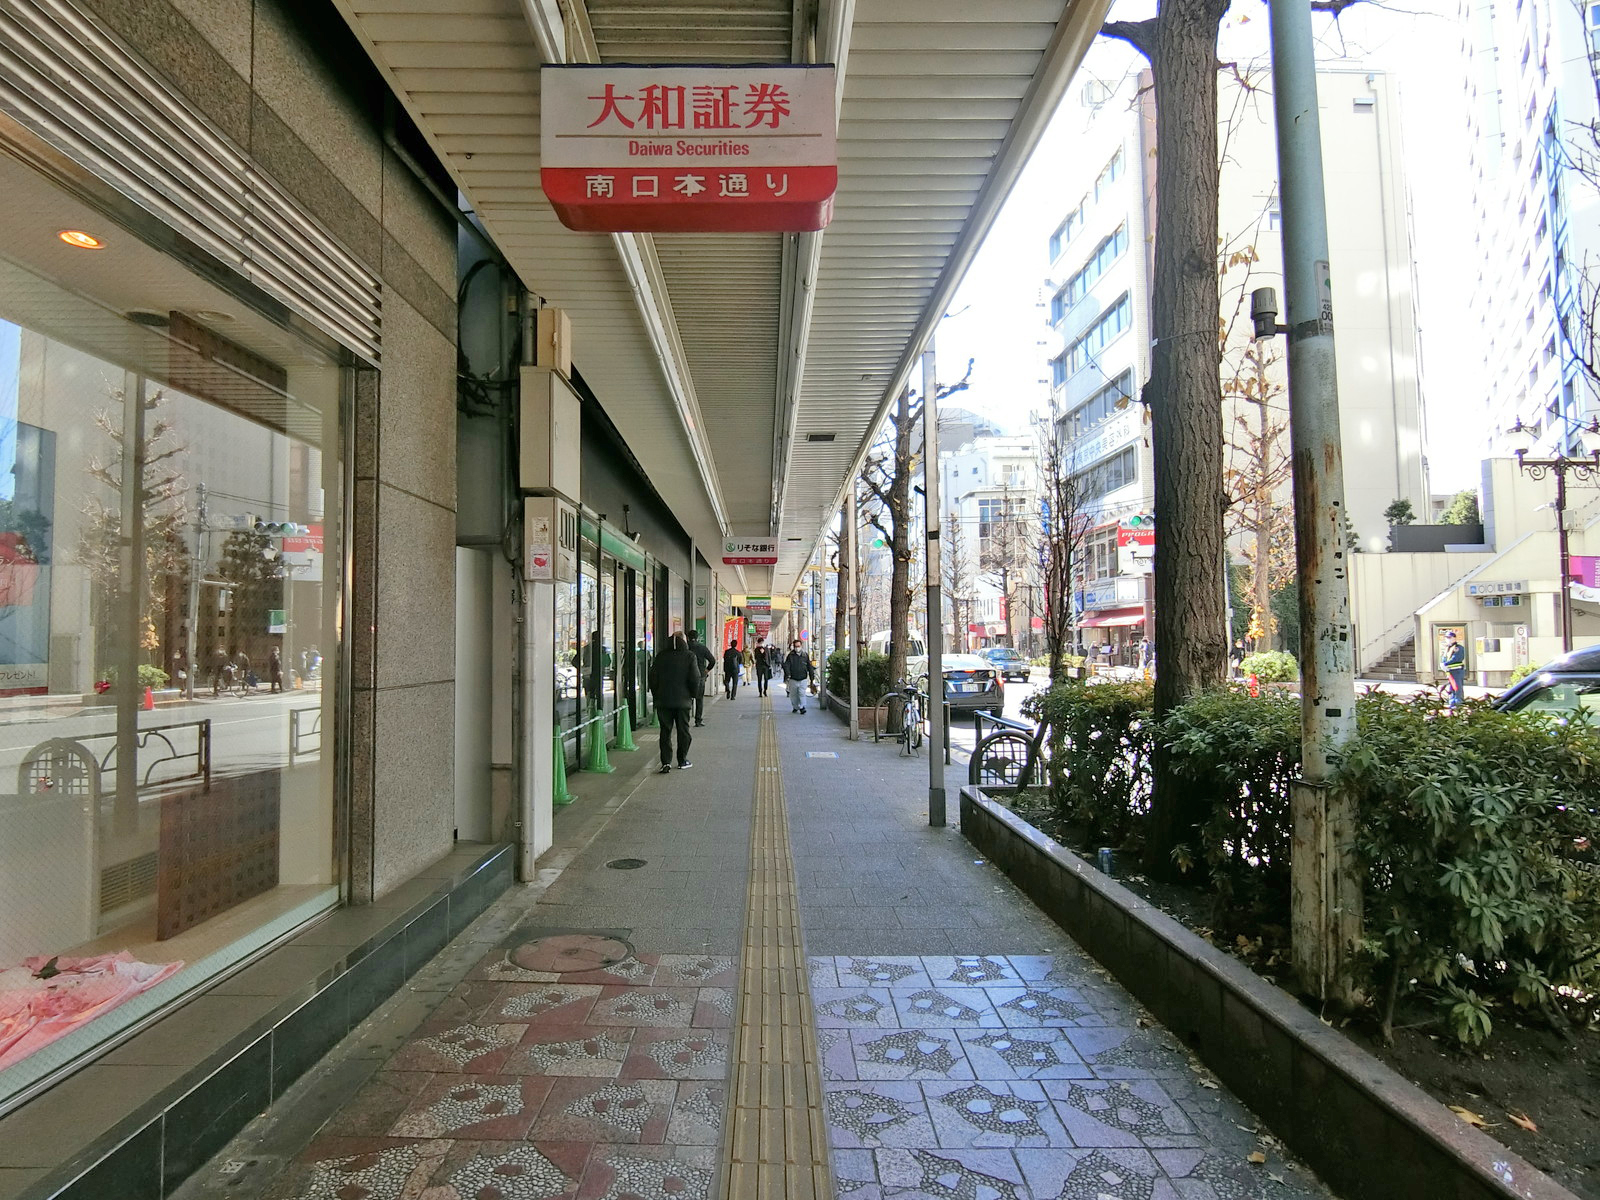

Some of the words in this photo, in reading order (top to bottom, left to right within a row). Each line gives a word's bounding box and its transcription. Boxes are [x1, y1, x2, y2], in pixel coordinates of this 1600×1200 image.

[587, 83, 791, 130] 大和証券
[628, 140, 673, 157] Daiwa
[676, 140, 750, 157] Securities
[585, 173, 789, 198] 南口本通り
[737, 544, 775, 552] りそな銀行
